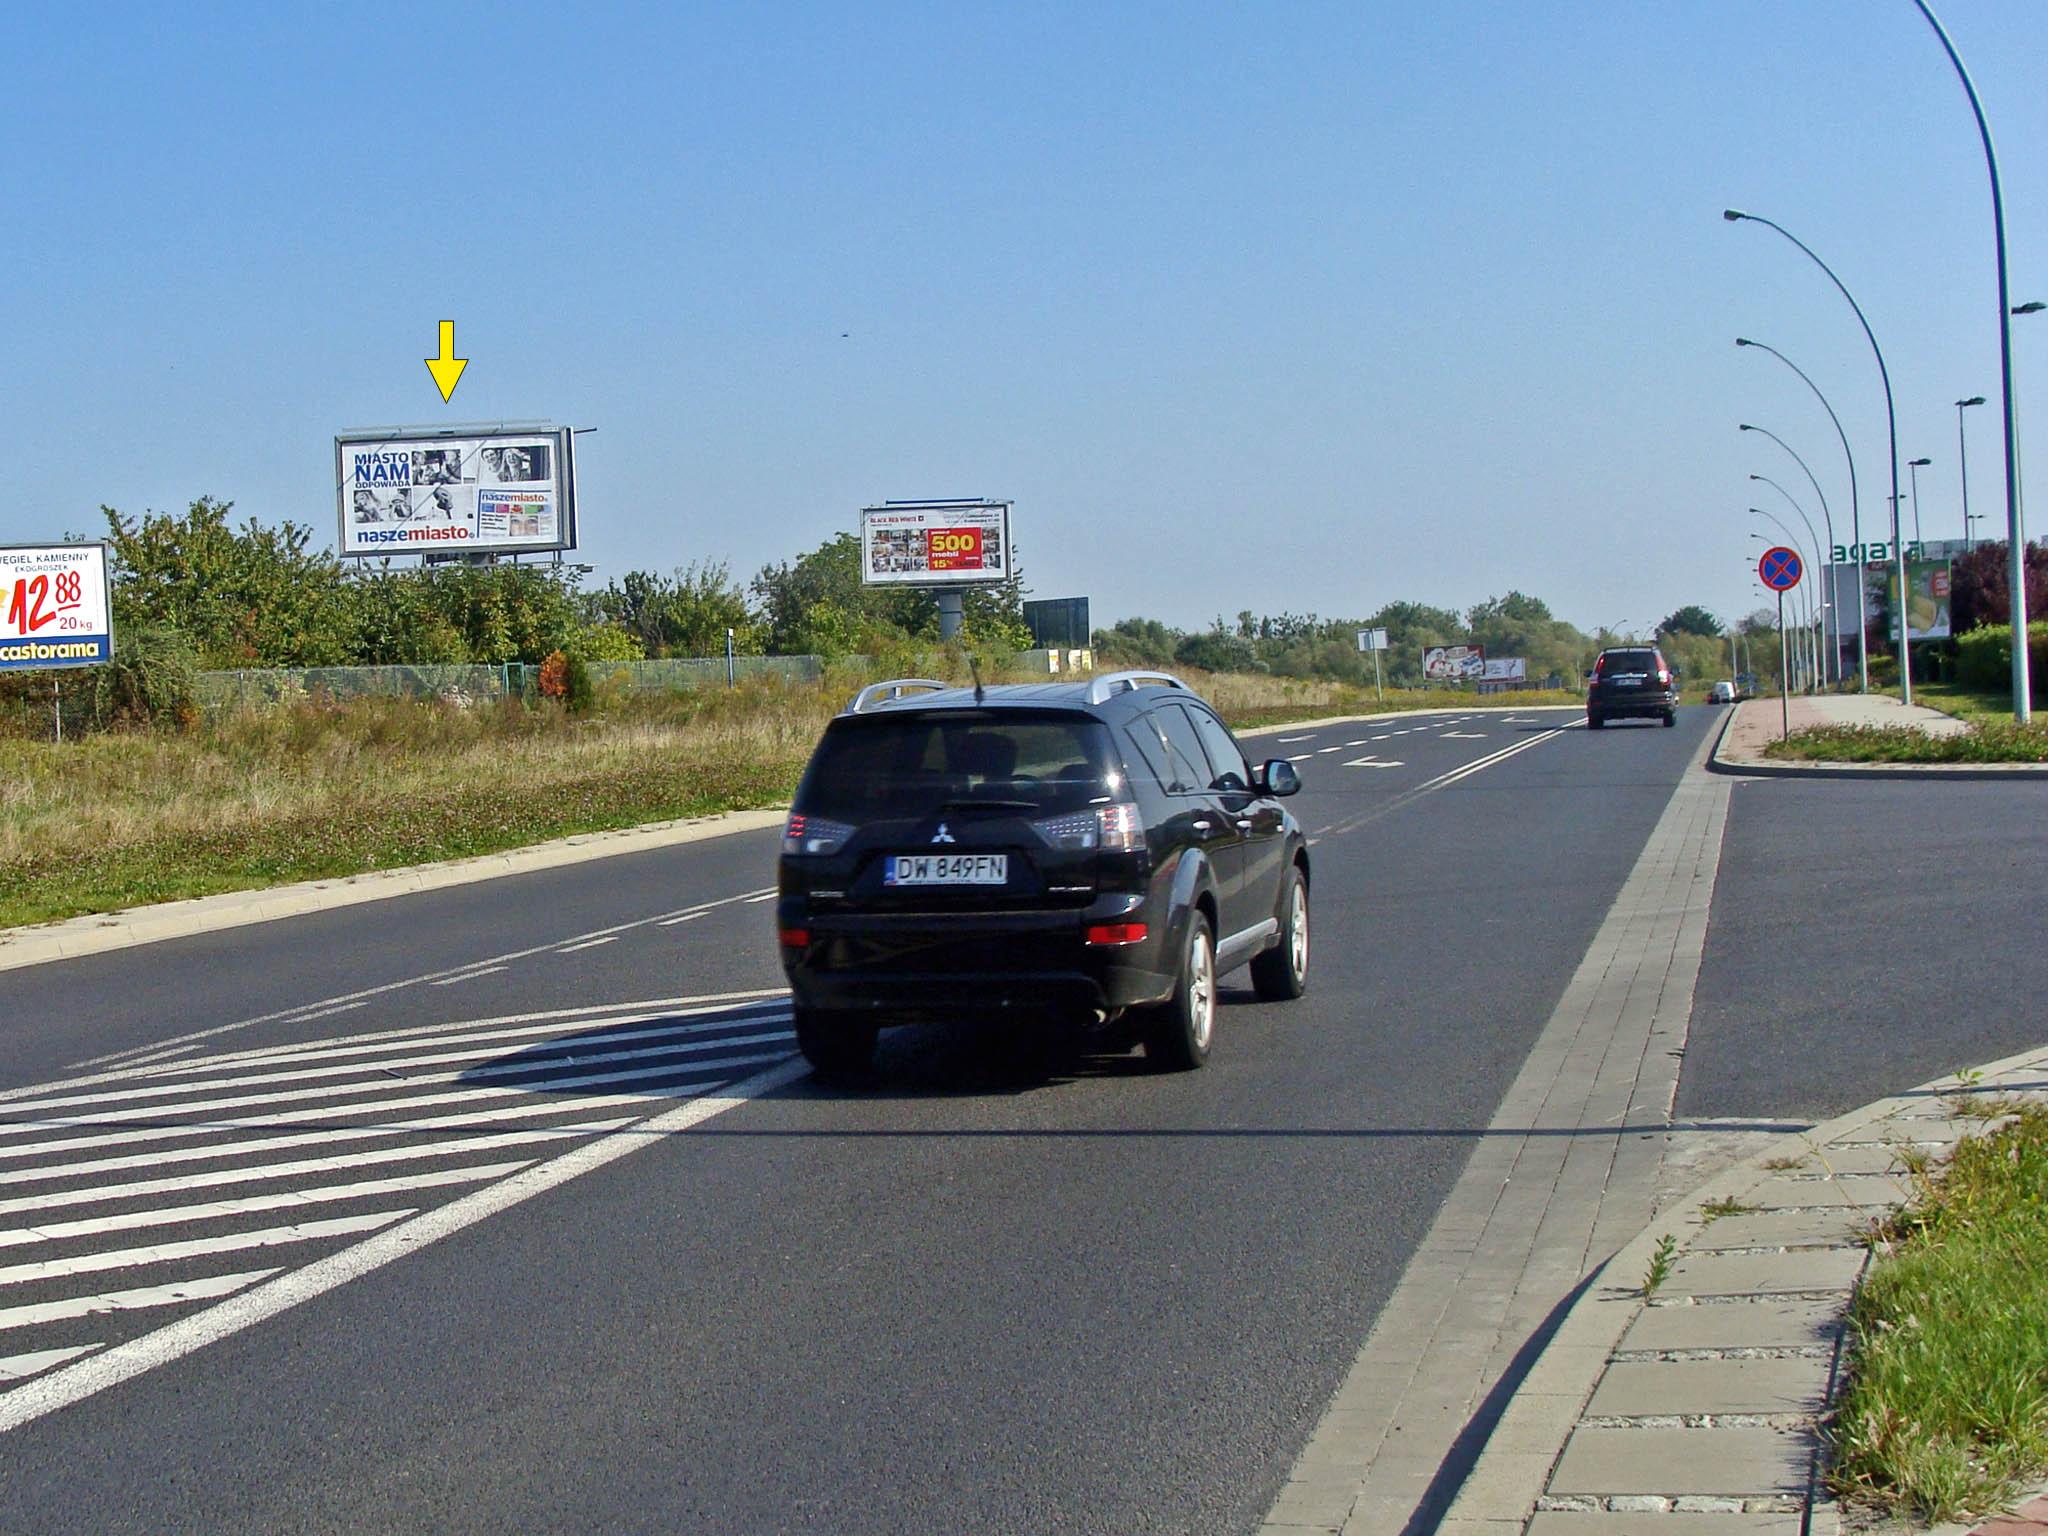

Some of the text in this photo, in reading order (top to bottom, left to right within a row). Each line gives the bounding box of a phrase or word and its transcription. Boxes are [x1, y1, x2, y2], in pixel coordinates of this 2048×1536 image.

[354, 453, 409, 465] MIASTO
[355, 464, 410, 481] NAM
[355, 480, 411, 489] ODPOWIADA
[931, 534, 975, 552] 500
[36, 553, 89, 563] KAMIENNY
[15, 564, 69, 573] EKOGROSZEK
[59, 616, 93, 632] 20 kg
[0, 642, 99, 661] castorama
[898, 857, 1004, 879] DW 849FN
